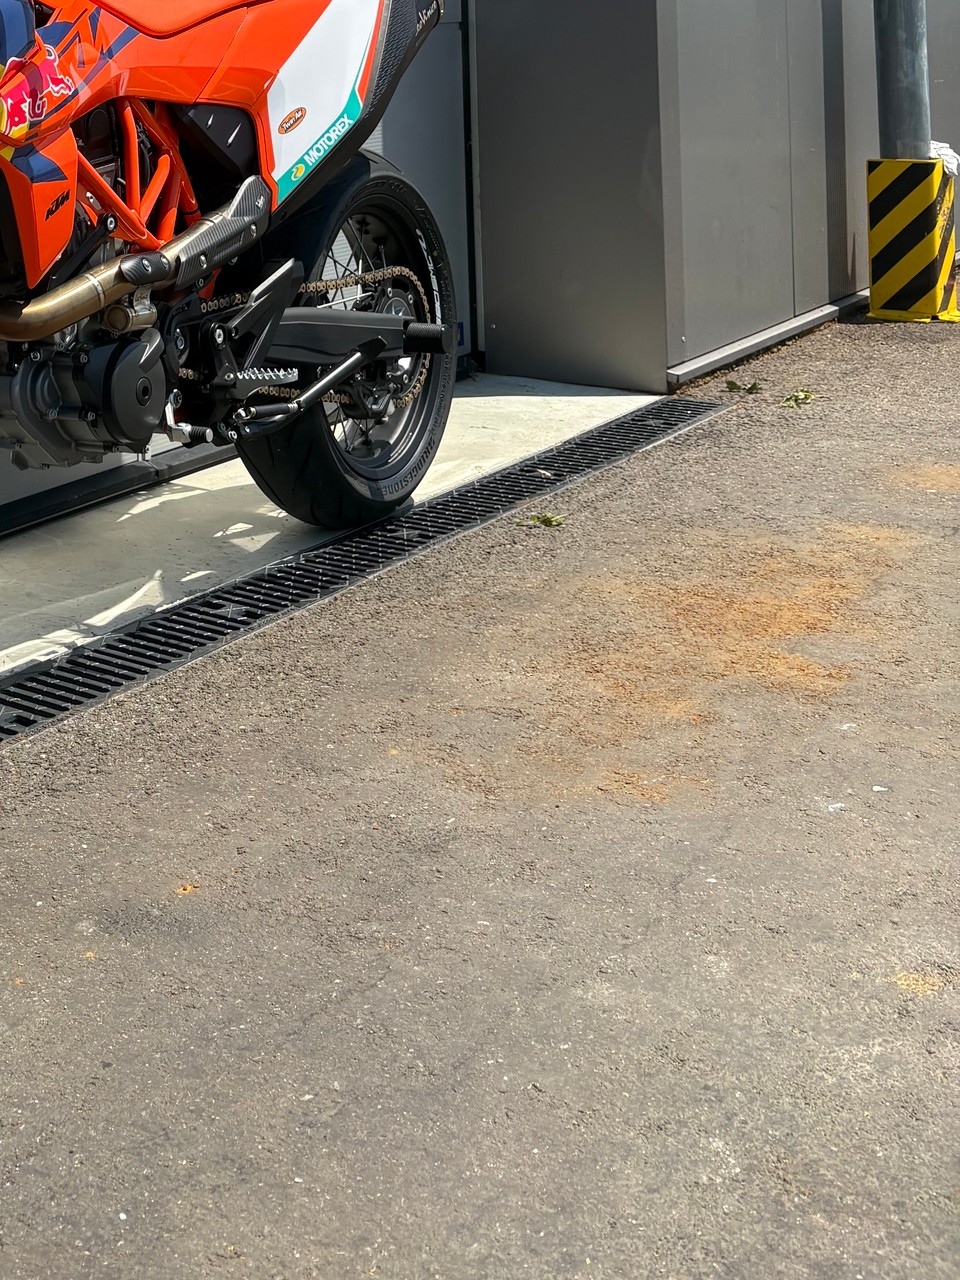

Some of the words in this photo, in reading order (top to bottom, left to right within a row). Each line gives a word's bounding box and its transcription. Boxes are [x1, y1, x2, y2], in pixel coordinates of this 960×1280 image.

[303, 113, 353, 166] MOTOREX
[44, 189, 70, 221] KTM
[382, 434, 436, 496] BRIDGESTONE
